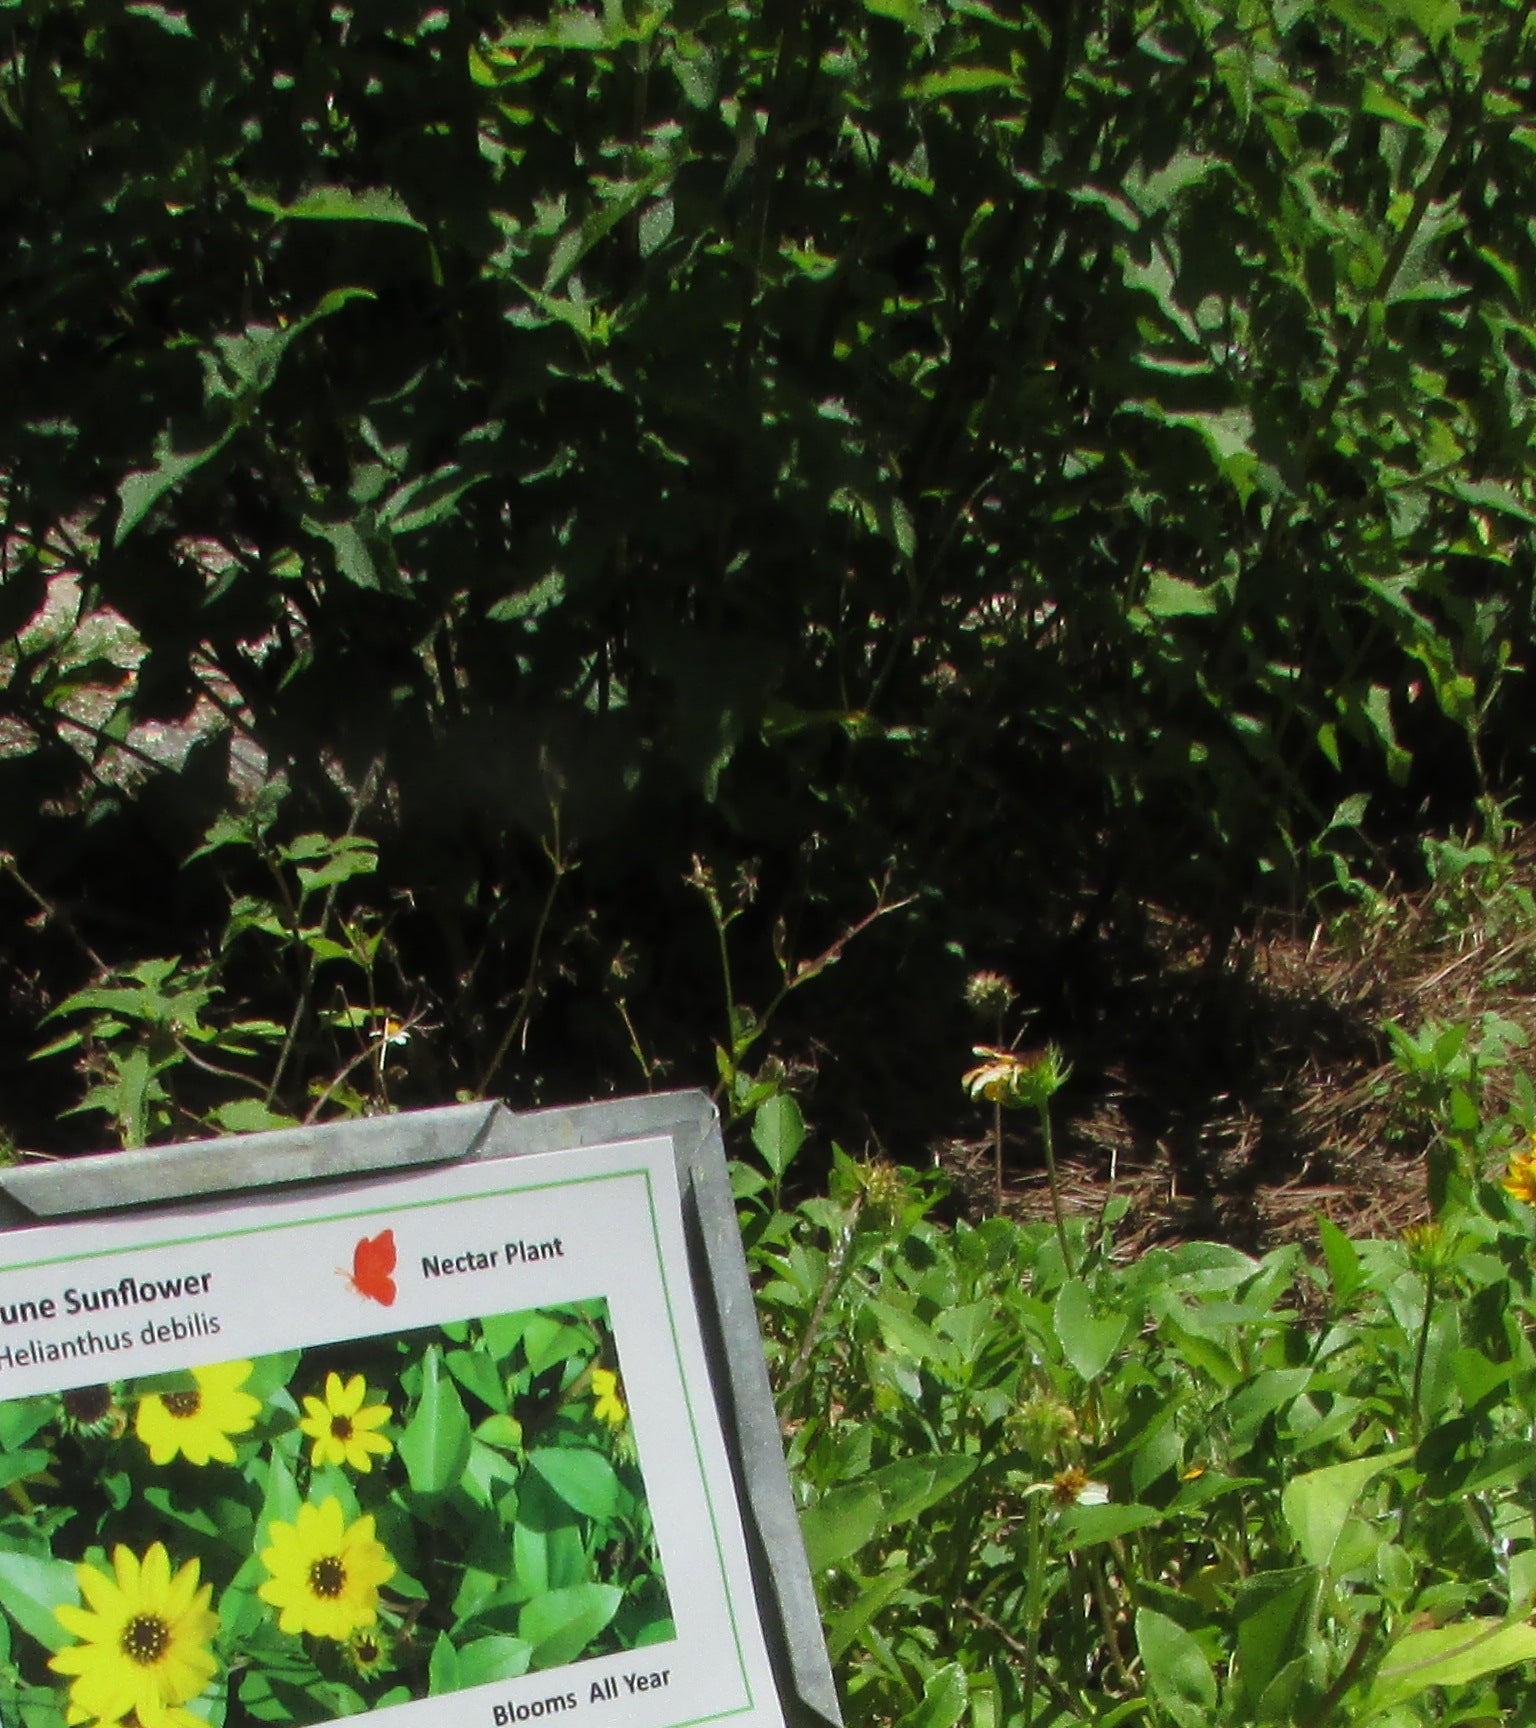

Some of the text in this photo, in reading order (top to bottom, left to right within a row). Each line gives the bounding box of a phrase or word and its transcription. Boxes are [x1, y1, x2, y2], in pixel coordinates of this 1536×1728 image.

[421, 1237, 564, 1279] Nectar Plant
[63, 1272, 213, 1315] Sunflower
[140, 1312, 221, 1345] debilis
[492, 1670, 670, 1727] Blooms All Year
